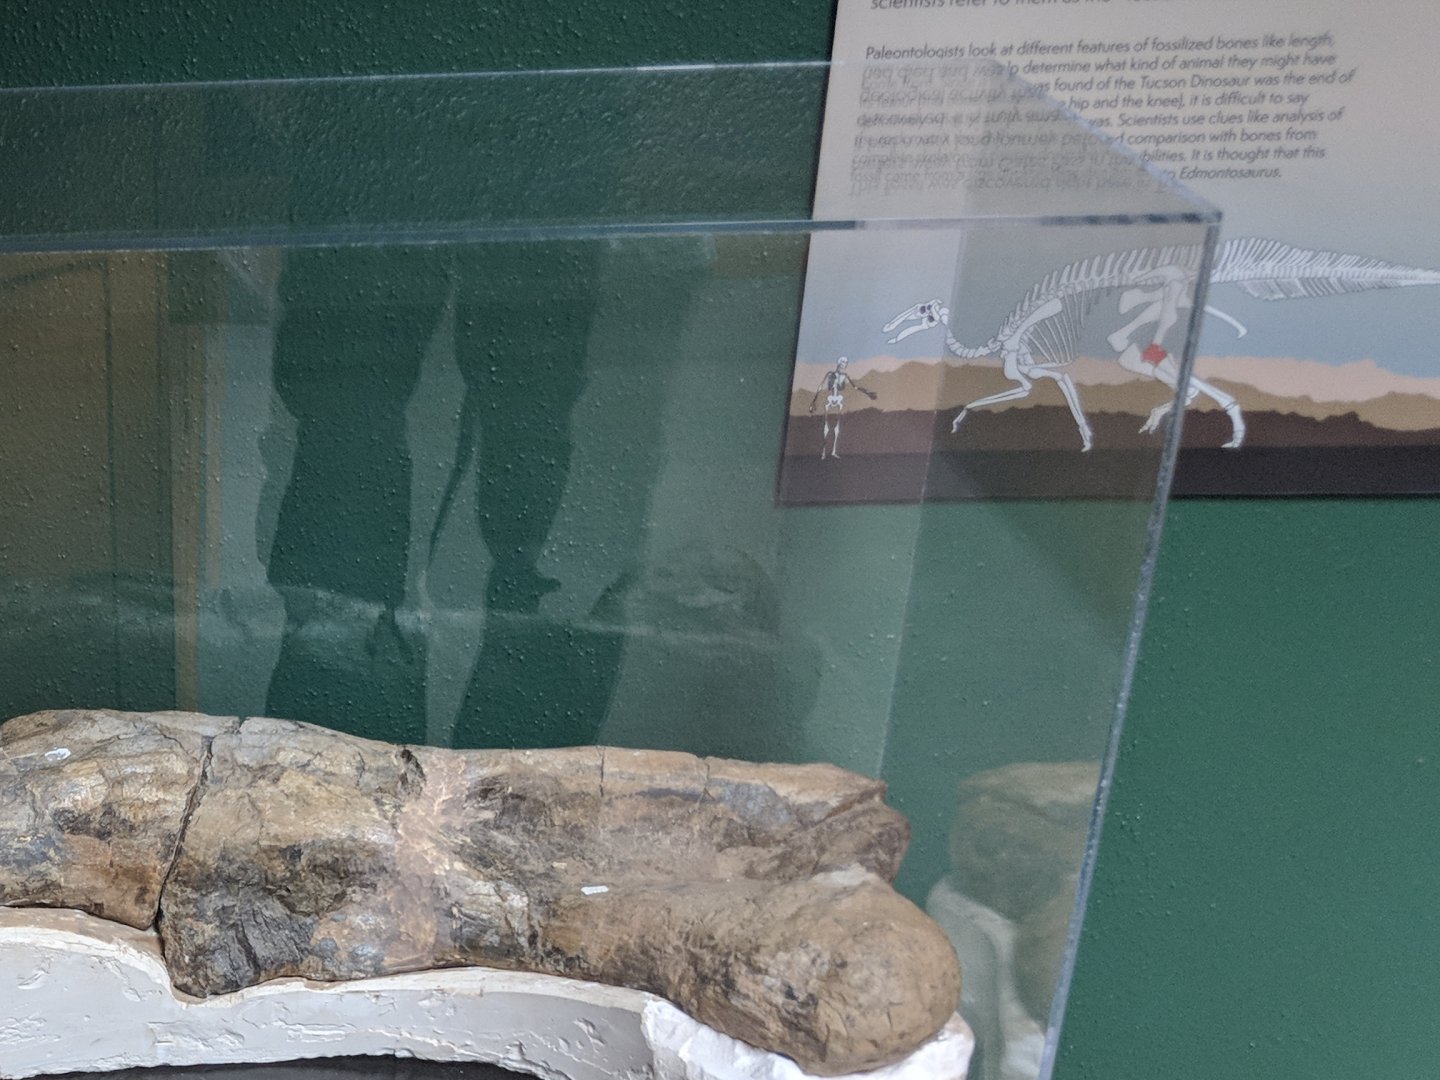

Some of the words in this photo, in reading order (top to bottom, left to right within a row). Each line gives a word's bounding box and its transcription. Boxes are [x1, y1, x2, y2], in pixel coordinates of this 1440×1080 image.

[865, 43, 965, 60] Paleontologists
[968, 41, 996, 57] look
[1000, 43, 1014, 56] at
[1016, 40, 1073, 56] different
[1075, 38, 1130, 54] features
[1132, 36, 1151, 53] of
[1151, 35, 1213, 51] fossilized
[1216, 35, 1259, 50] bones
[1262, 33, 1285, 48] like
[1023, 58, 1092, 74] determine
[1095, 57, 1127, 72] what
[1130, 55, 1160, 71] kind
[1161, 54, 1178, 70] of
[1179, 53, 1226, 69] animal
[1228, 53, 1258, 70] they
[1260, 51, 1301, 70] might
[1303, 50, 1337, 66] have
[1053, 76, 1095, 92] found
[1096, 75, 1112, 91] of
[1114, 75, 1137, 90] the
[1140, 74, 1187, 90] Tucson
[1190, 73, 1251, 88] Dinosaur
[1254, 74, 1281, 87] was
[1283, 71, 1304, 85] the
[1308, 69, 1338, 85] end
[1339, 67, 1358, 83] of
[1069, 94, 1090, 112] hip
[1092, 93, 1120, 109] and
[1122, 93, 1144, 108] the
[1189, 92, 1199, 107] it
[1200, 92, 1212, 106] is
[1214, 90, 1267, 106] difficult
[1269, 91, 1284, 105] to
[1286, 93, 1310, 108] say
[1117, 112, 1179, 127] Scientists
[1182, 114, 1207, 126] use
[1208, 110, 1244, 125] clues
[1247, 110, 1269, 124] like
[1272, 108, 1325, 126] analysis
[1327, 106, 1347, 122] of
[1127, 132, 1206, 148] comparison
[1209, 128, 1237, 143] with
[1240, 128, 1282, 142] bones
[1285, 127, 1319, 141] from
[1191, 148, 1202, 161] It
[1203, 148, 1214, 160] is
[1216, 146, 1271, 164] thought
[1273, 146, 1301, 160] that
[1303, 144, 1327, 159] this
[1179, 165, 1283, 181] Edmontosaurus.
